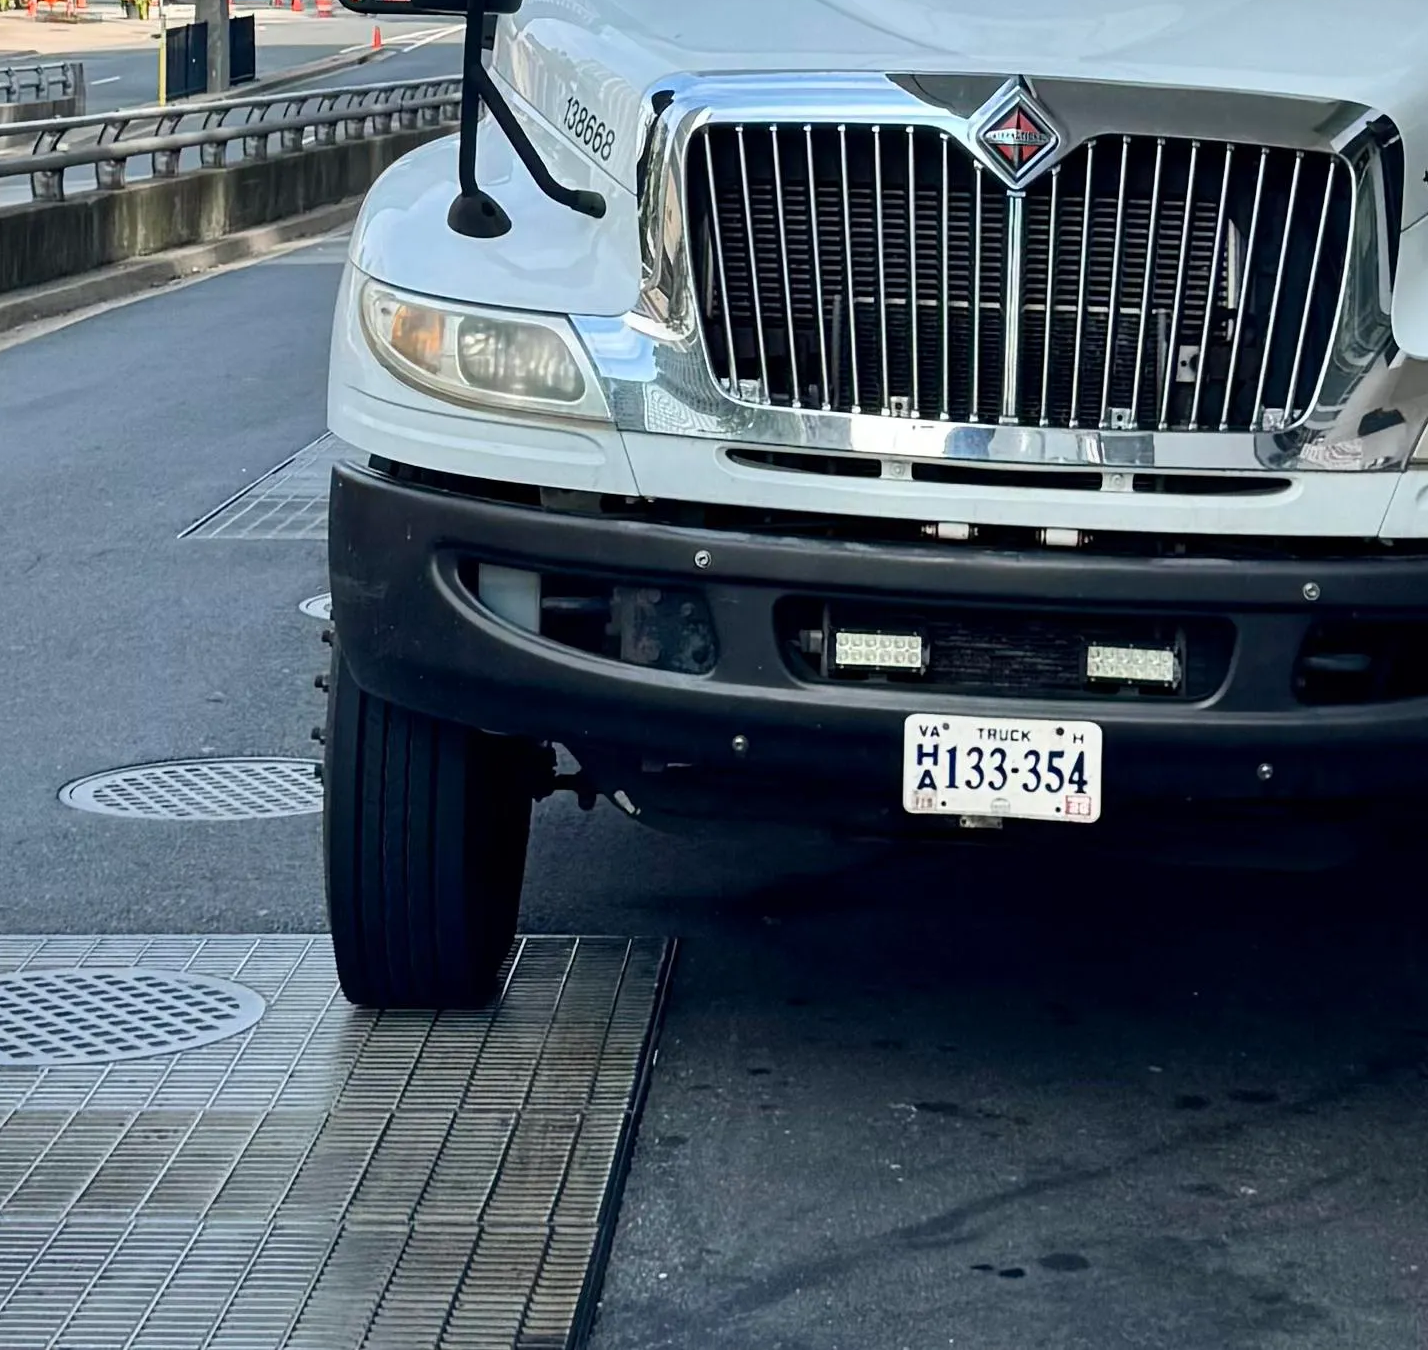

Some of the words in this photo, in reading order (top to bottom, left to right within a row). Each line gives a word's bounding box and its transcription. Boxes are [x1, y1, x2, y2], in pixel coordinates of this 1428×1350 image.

[564, 95, 615, 161] 138668
[918, 725, 941, 738] VA
[976, 727, 1032, 743] TRUCK
[1072, 733, 1085, 745] H
[944, 745, 1089, 794] 133-354
